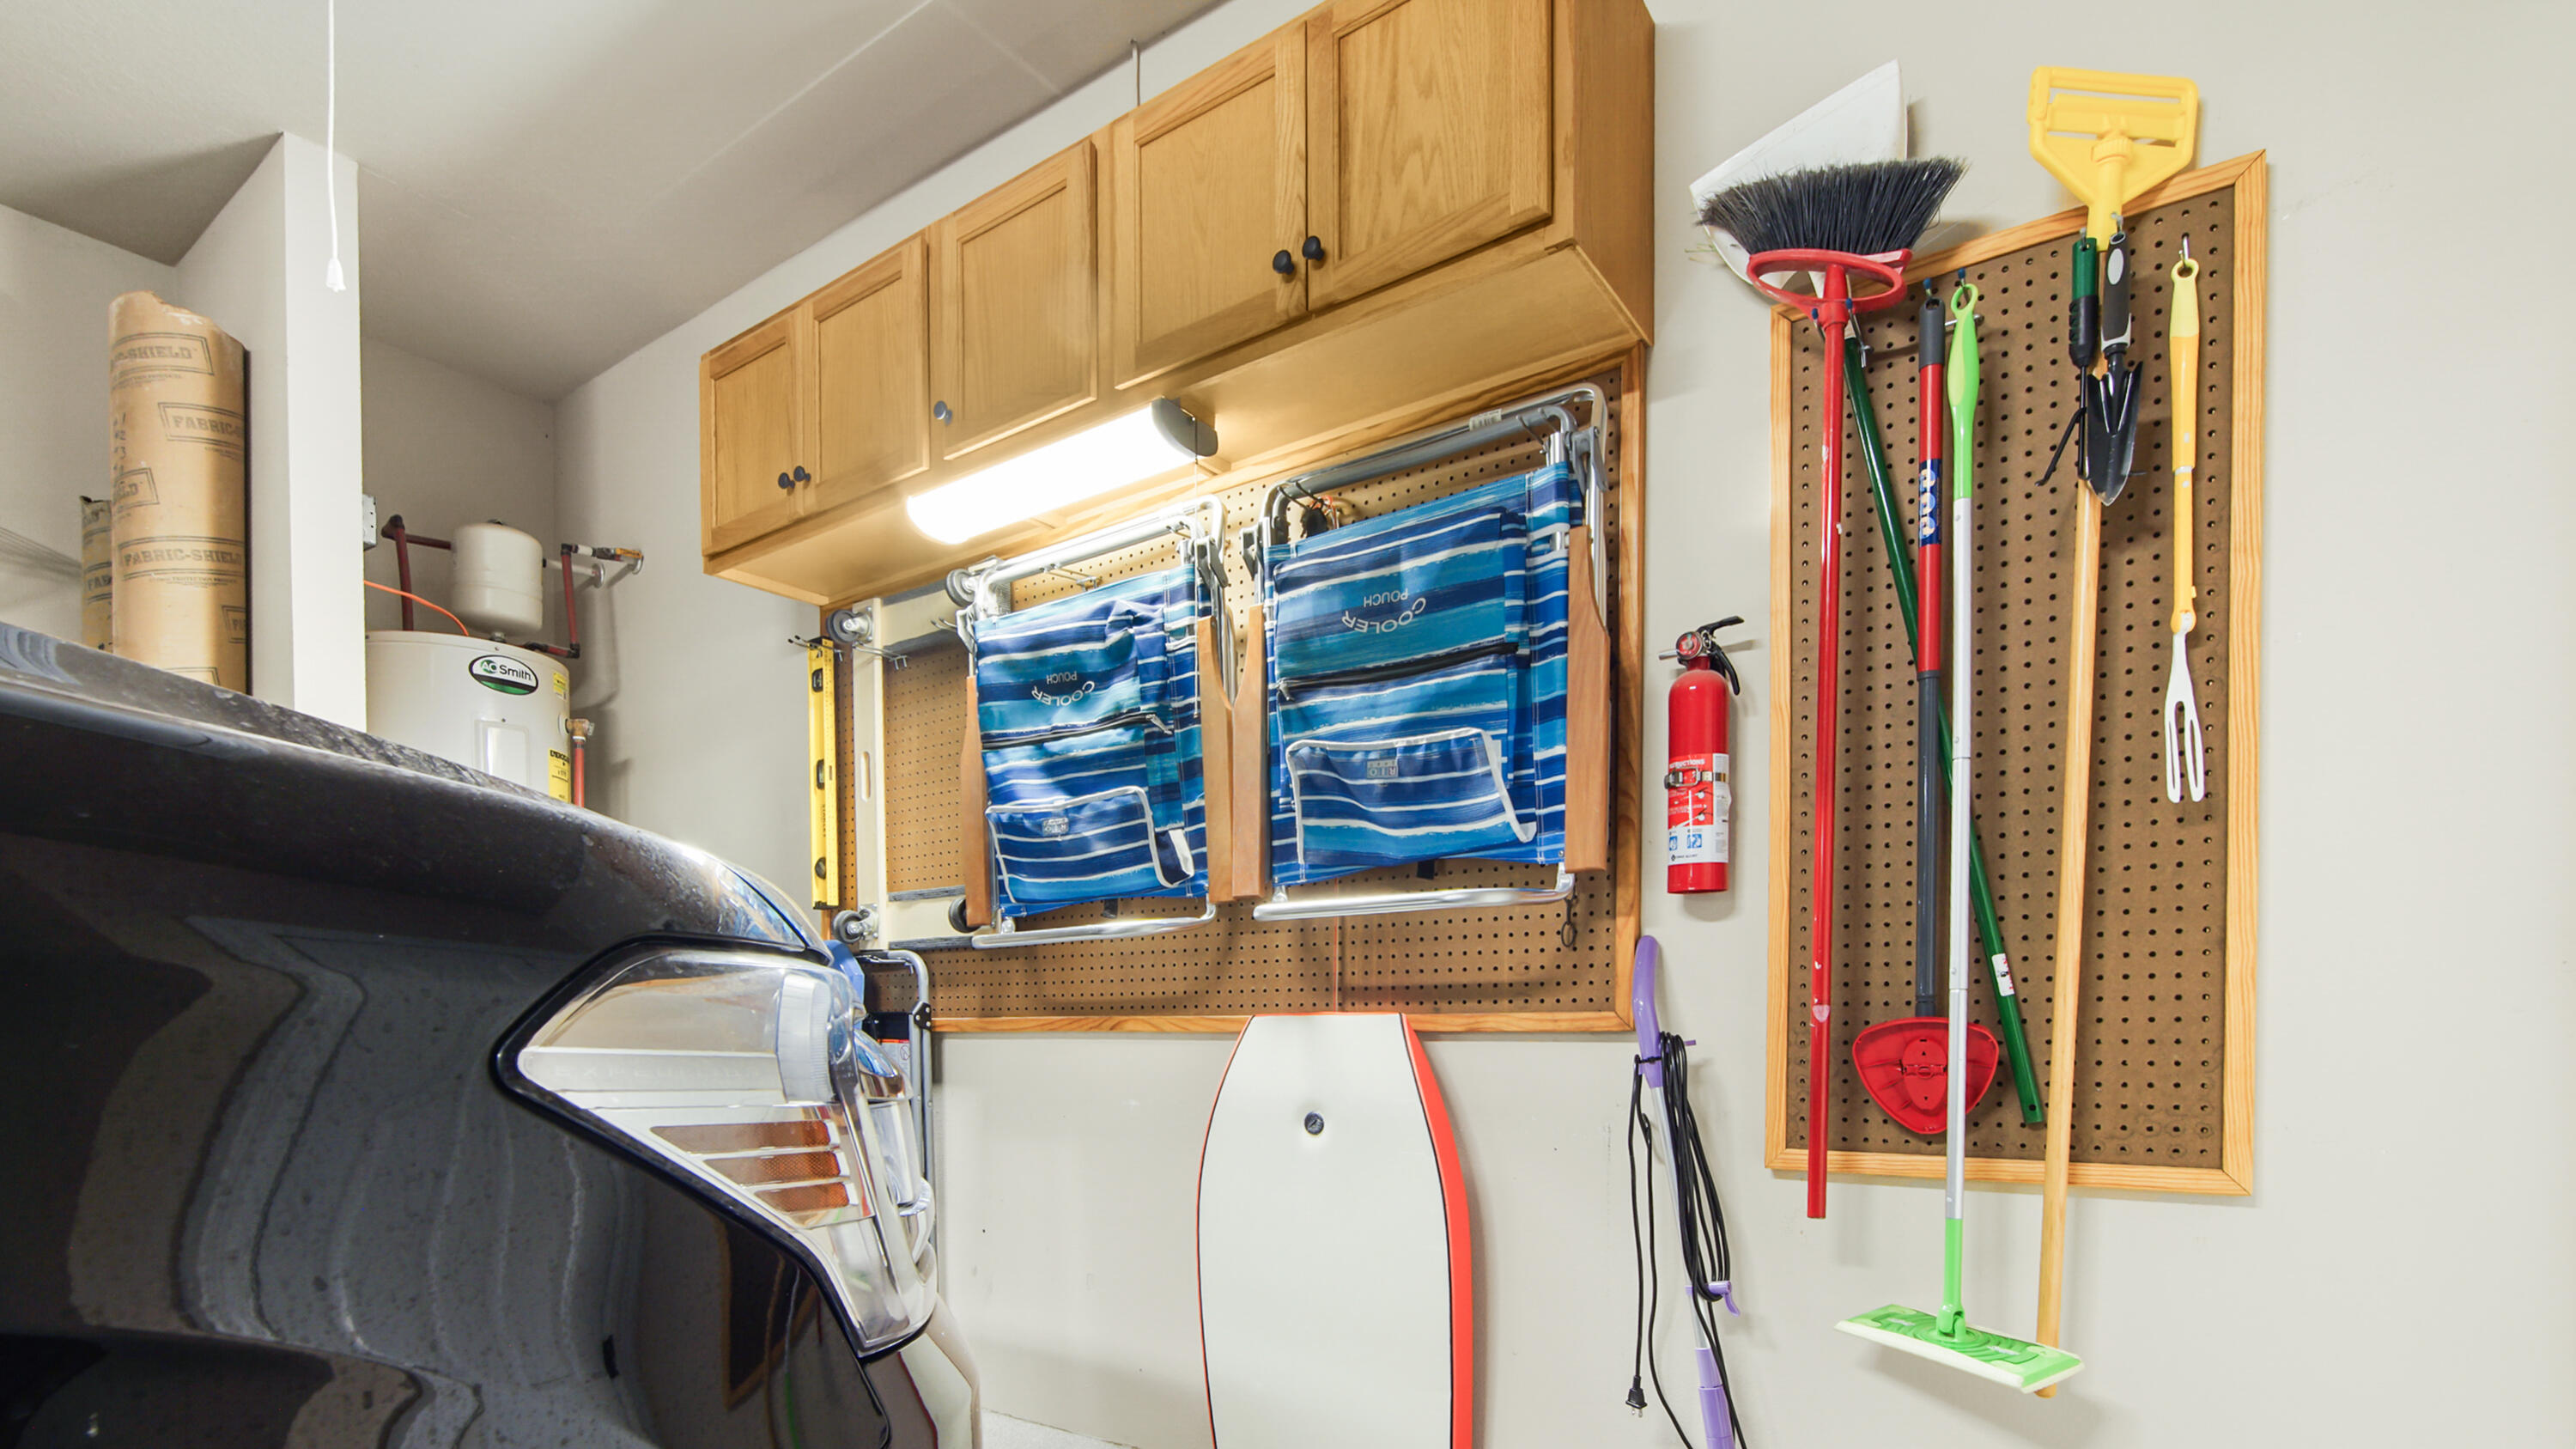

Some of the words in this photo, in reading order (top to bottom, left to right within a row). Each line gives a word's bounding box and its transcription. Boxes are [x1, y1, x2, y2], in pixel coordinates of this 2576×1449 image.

[1364, 588, 1408, 608] POUCH
[1340, 597, 1426, 634] COOLER
[499, 664, 532, 681] Smith
[1046, 671, 1078, 685] POUCH
[1031, 680, 1095, 706] COOLER
